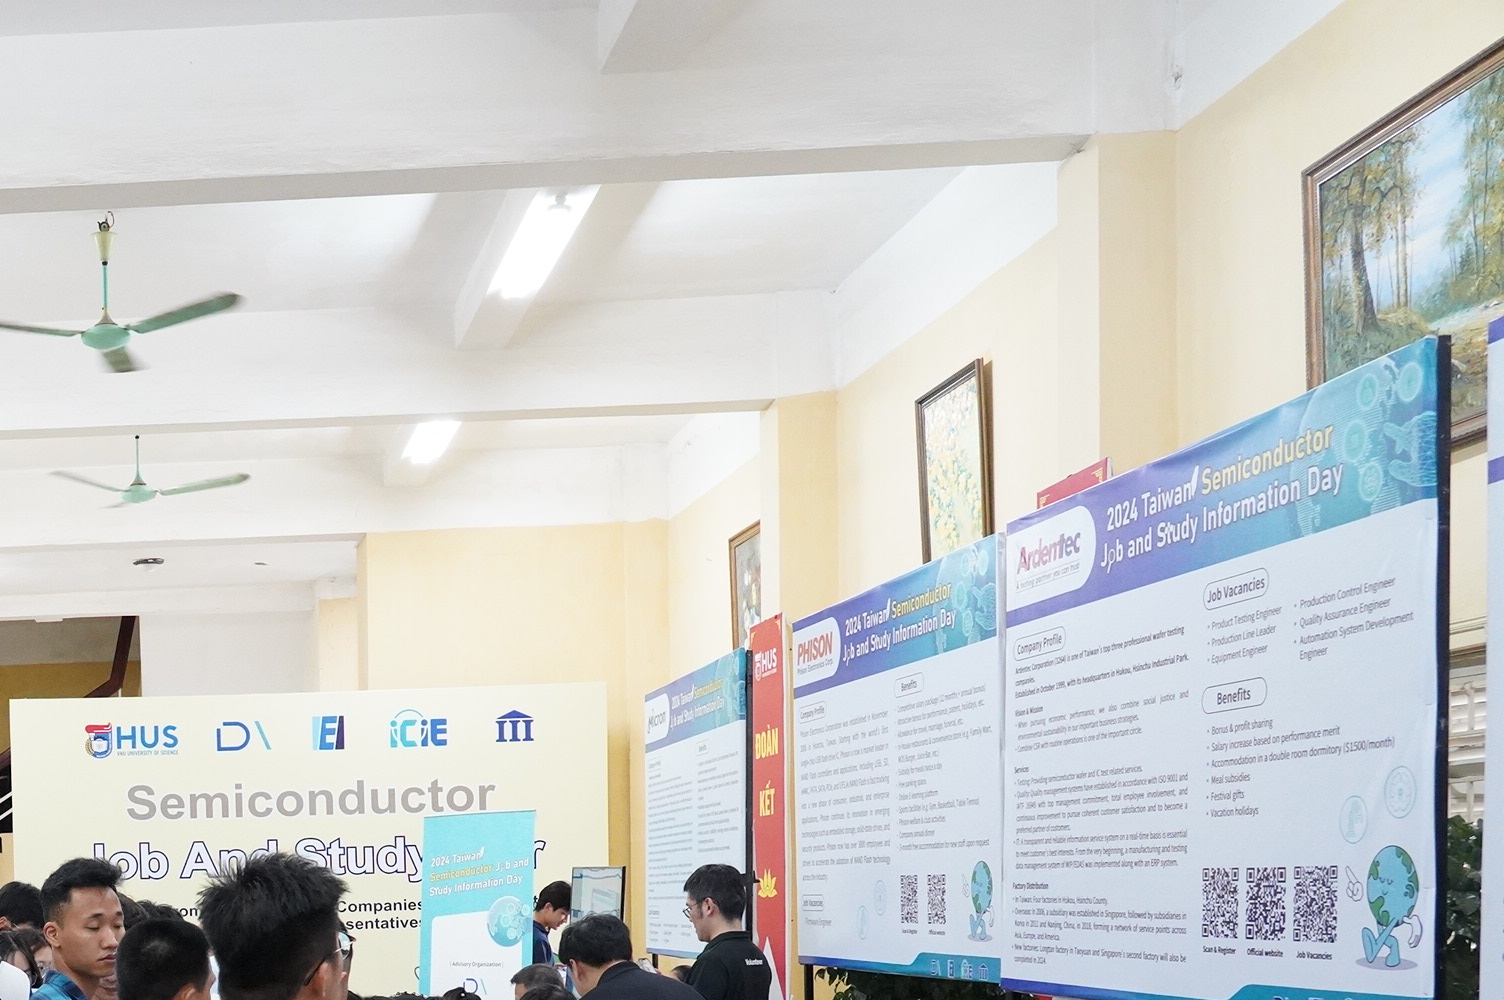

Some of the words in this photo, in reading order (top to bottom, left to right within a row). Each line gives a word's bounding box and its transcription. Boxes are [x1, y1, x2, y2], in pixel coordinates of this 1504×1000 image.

[1107, 498, 1138, 531] 2024
[1141, 482, 1193, 518] Taiwan
[1201, 425, 1334, 495] Semiconductor
[1101, 539, 1123, 573] Job
[1128, 527, 1152, 558] and
[1157, 515, 1198, 547] Study
[1203, 478, 1300, 533] Information
[1307, 463, 1343, 496] Day
[1207, 589, 1222, 603] Job
[1224, 577, 1265, 599] Vacancies
[1300, 593, 1335, 609] Production
[1337, 586, 1363, 600] Control
[1364, 577, 1396, 596] Engineer
[845, 620, 862, 636] 2024
[863, 607, 887, 628] Taiwan
[892, 583, 952, 618] Semiconductor
[1212, 617, 1233, 630] Product
[1234, 612, 1255, 626] Testing
[1256, 606, 1282, 623] Engineer
[1300, 613, 1323, 628] Quality
[1324, 606, 1358, 622] Assurance
[1359, 598, 1392, 616] Engineer
[857, 642, 869, 658] and
[871, 630, 891, 651] Study
[893, 617, 938, 644] Information
[940, 608, 956, 629] Day
[1212, 633, 1242, 647] Production
[1243, 629, 1255, 640] Line
[1256, 624, 1277, 637] Leader
[1300, 629, 1338, 645] Automation
[1339, 623, 1364, 638] System
[1365, 612, 1414, 633] Development
[797, 631, 833, 665] PHISON
[1017, 642, 1042, 655] Company
[1043, 633, 1062, 647] Profile
[1212, 650, 1241, 665] Equipment
[1242, 644, 1268, 658] Engineer
[1300, 645, 1328, 662] Engineer
[761, 648, 777, 673] HUS
[901, 680, 917, 692] Benefits
[1216, 687, 1251, 706] Benefits
[116, 725, 179, 749] HUS
[1211, 724, 1228, 735] Bonus
[1229, 723, 1234, 733] &
[1234, 720, 1250, 734] profit
[1251, 717, 1273, 730] sharing
[1211, 740, 1228, 753] Salary
[1229, 737, 1252, 749] increase
[1254, 734, 1271, 746] based
[1272, 735, 1280, 744] on
[1281, 728, 1321, 746] performance
[1322, 726, 1340, 738] merit
[1211, 753, 1256, 768] Accommodation
[1258, 754, 1263, 763] in
[1269, 750, 1290, 761] double
[1291, 749, 1308, 759] room
[1309, 744, 1341, 758] dormitory
[1211, 774, 1224, 784] Meal
[1225, 772, 1250, 783] subsidies
[127, 778, 496, 821] Semiconductor
[1211, 790, 1232, 801] Festival
[1232, 789, 1245, 802] gifts
[1210, 808, 1234, 818] Vacation
[1235, 806, 1259, 818] holidays
[430, 865, 493, 882] Semiconductor
[513, 857, 529, 868] and
[431, 857, 449, 867] 2024
[452, 852, 481, 863] Taiwan
[429, 885, 451, 897] Study
[454, 878, 503, 893] Information
[506, 875, 523, 886] Day
[337, 899, 423, 914] Companies
[1218, 946, 1236, 955] Register
[1247, 948, 1264, 957] Official
[1265, 948, 1283, 958] website
[1296, 951, 1305, 960] Job
[1306, 951, 1332, 961] Vacancies
